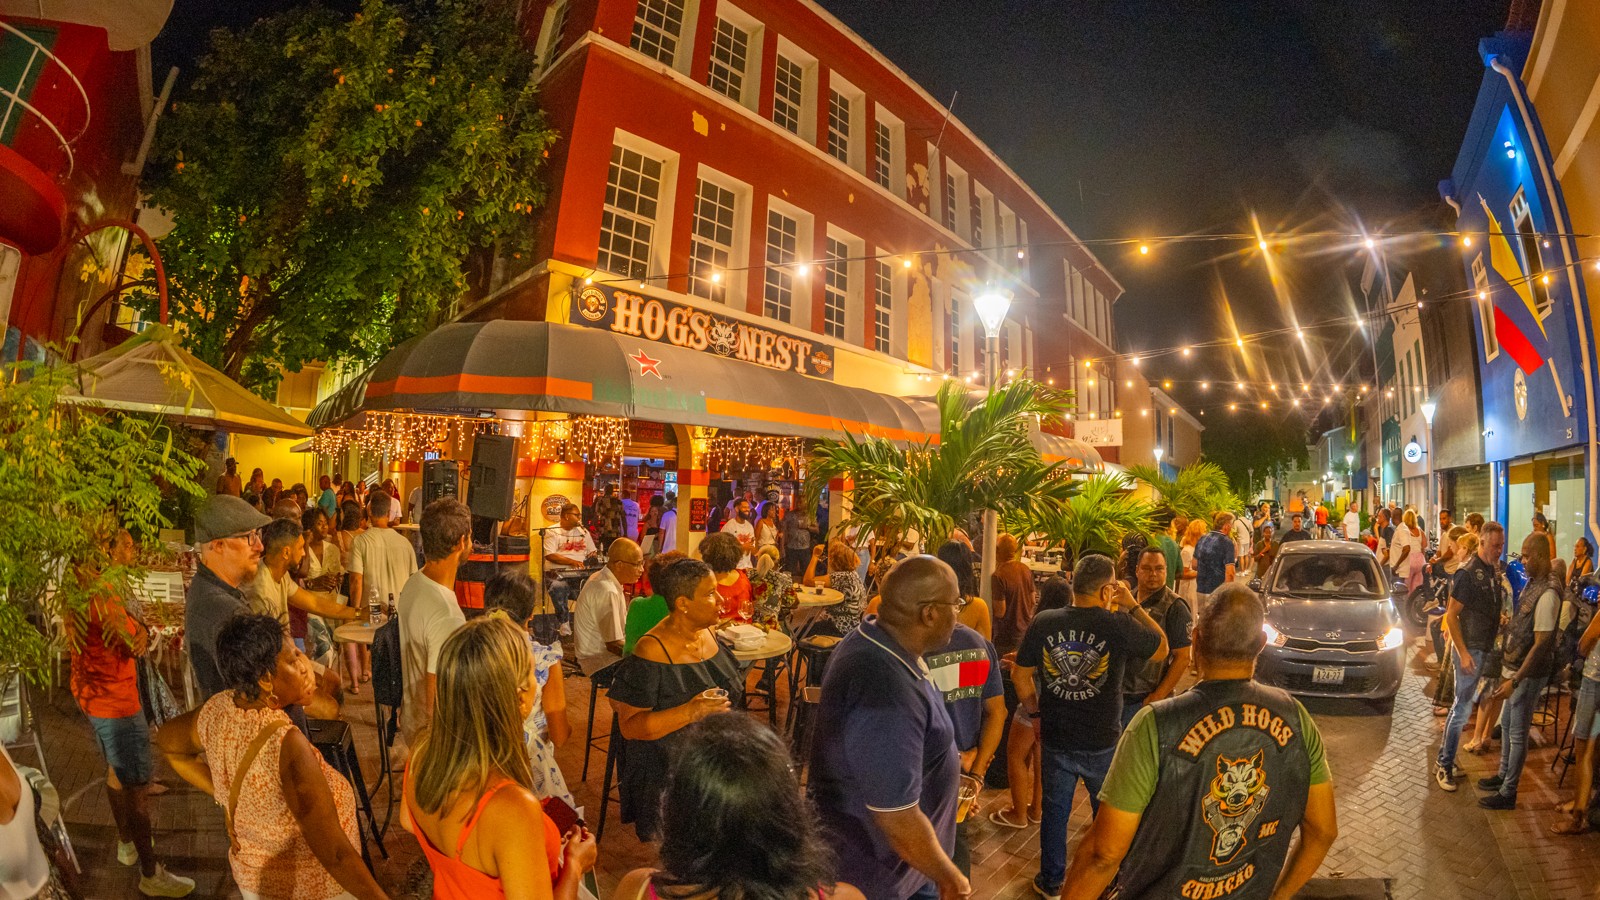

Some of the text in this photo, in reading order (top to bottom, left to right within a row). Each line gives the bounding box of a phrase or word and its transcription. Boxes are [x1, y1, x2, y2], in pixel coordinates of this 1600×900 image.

[610, 291, 711, 351] HOG'S
[735, 323, 812, 374] NEST
[1046, 629, 1107, 652] PARIBA
[932, 651, 986, 666] TOMMY
[1053, 688, 1095, 701] BIKERS
[1177, 703, 1294, 757] WILD HOGS
[1258, 820, 1280, 839] MC
[1181, 863, 1255, 900] CURAÇAO
